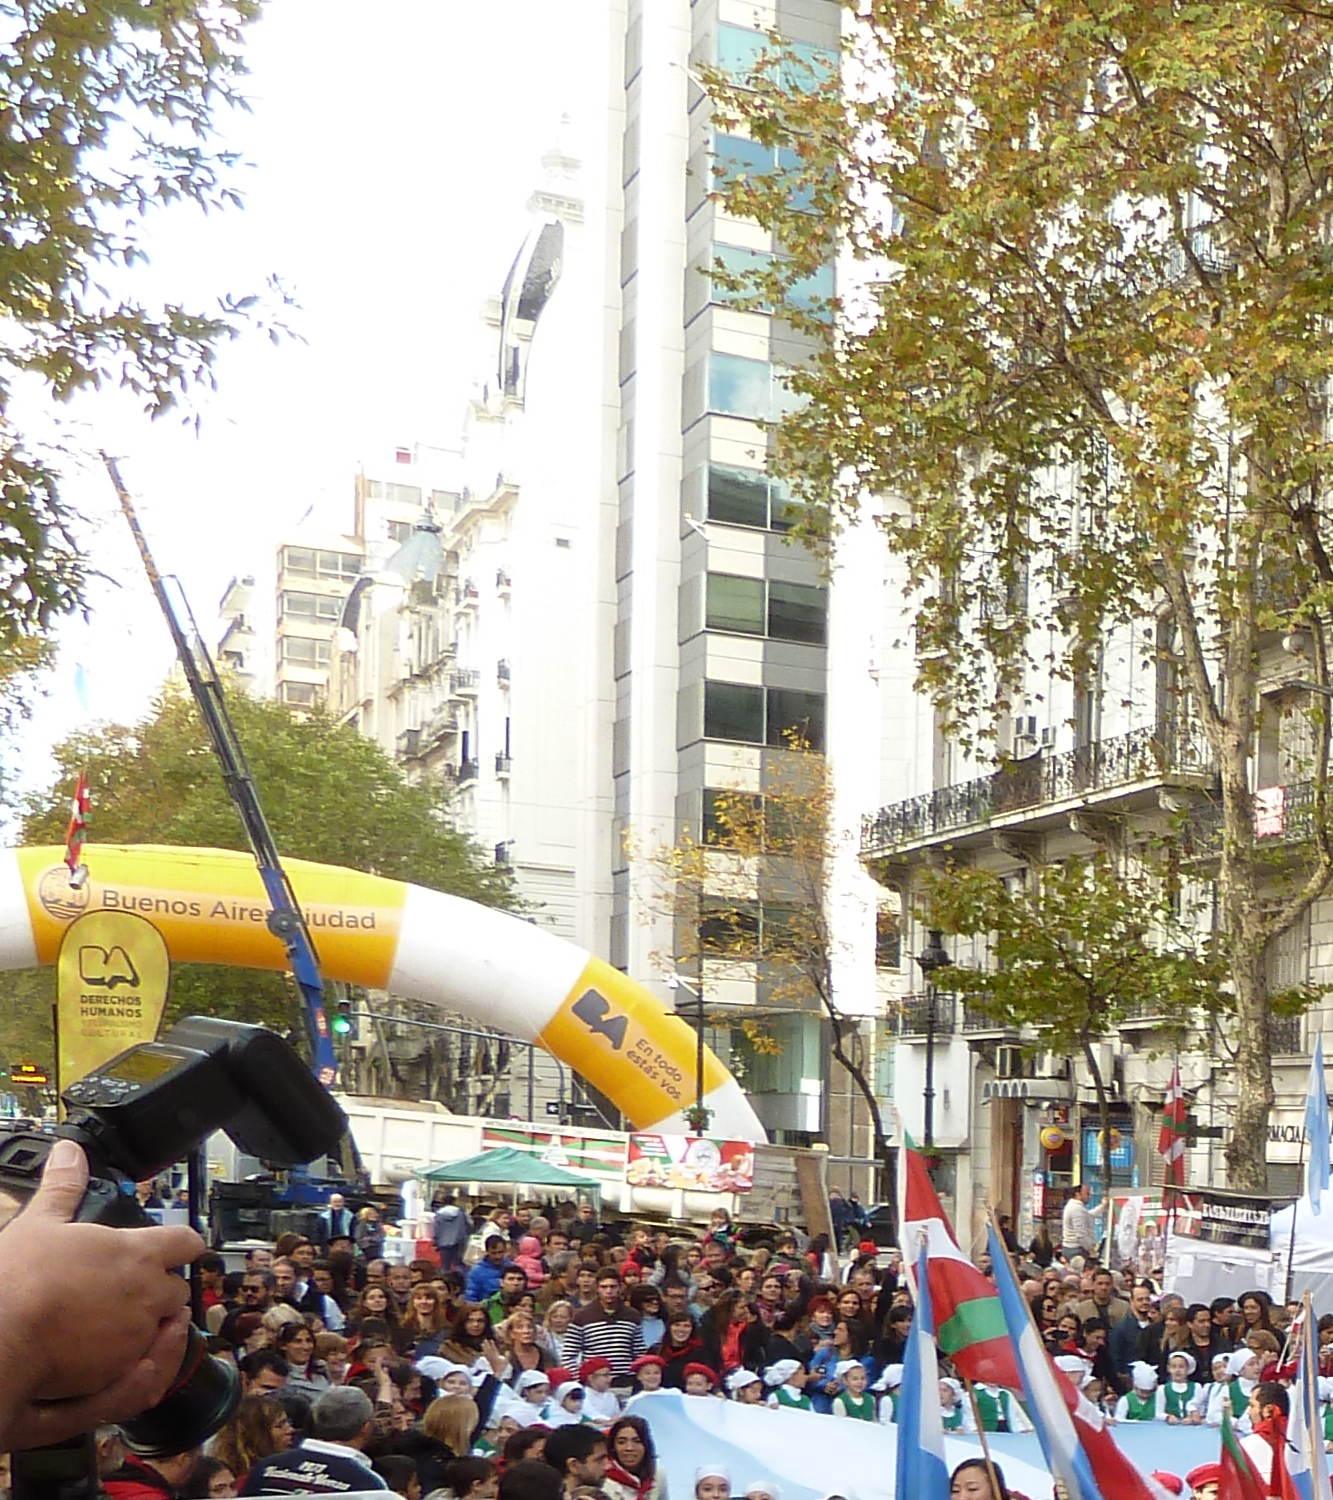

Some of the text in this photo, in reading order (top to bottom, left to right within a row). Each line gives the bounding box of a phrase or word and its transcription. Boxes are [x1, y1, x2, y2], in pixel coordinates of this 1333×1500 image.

[103, 890, 377, 930] Buenos Aires iudad
[80, 994, 142, 1006] DERECHOS
[80, 1006, 142, 1018] HUMANOS
[571, 988, 629, 1051] BA
[626, 1050, 682, 1100] estás vos
[635, 1038, 683, 1083] En todo
